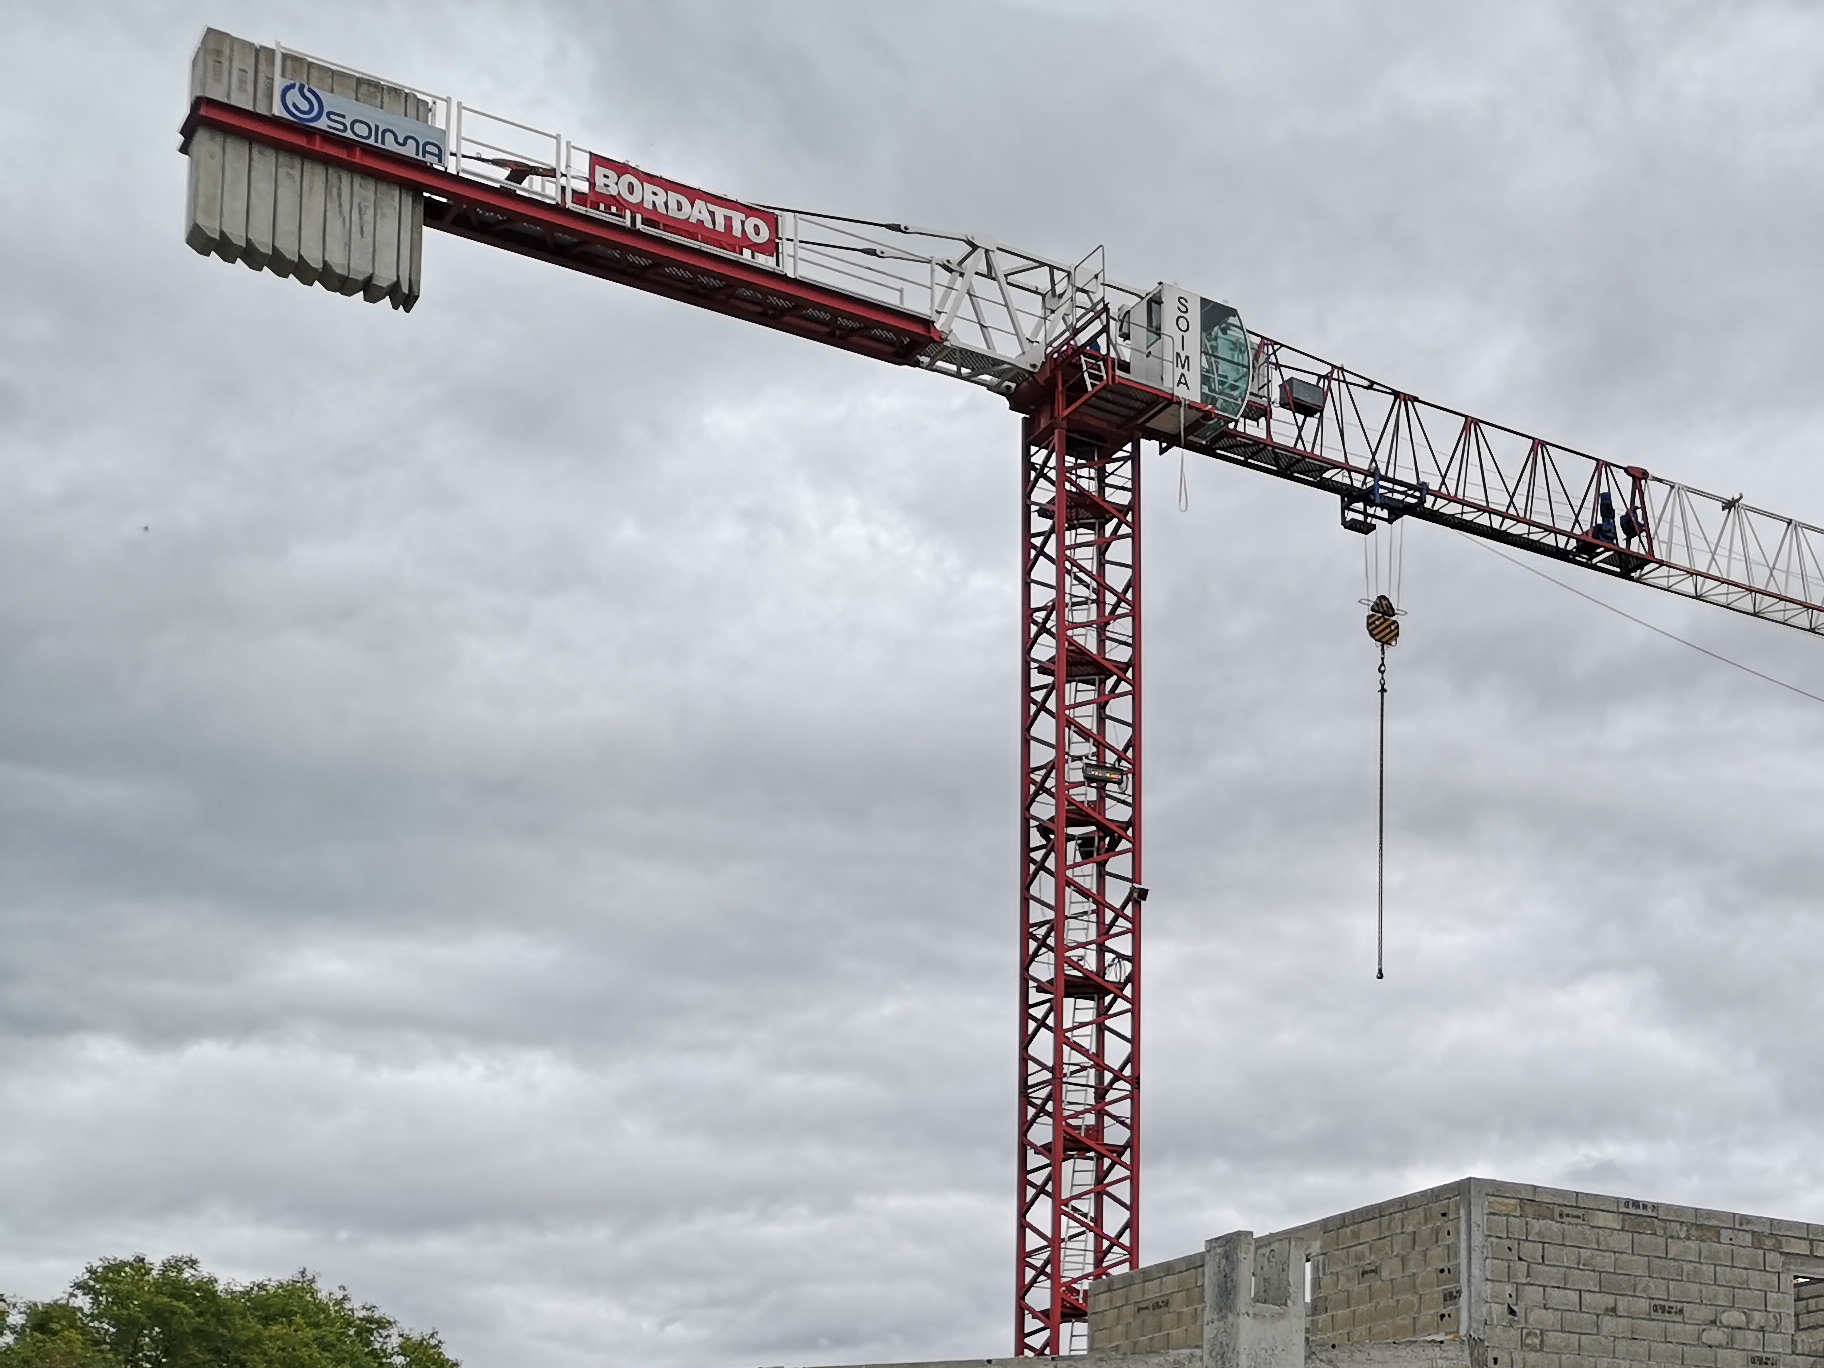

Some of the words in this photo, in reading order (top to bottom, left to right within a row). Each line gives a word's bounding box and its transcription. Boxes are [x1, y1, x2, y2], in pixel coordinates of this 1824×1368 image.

[325, 110, 443, 163] SOIMA
[594, 164, 771, 244] BORDATTO
[1175, 295, 1190, 391] SOIMA
